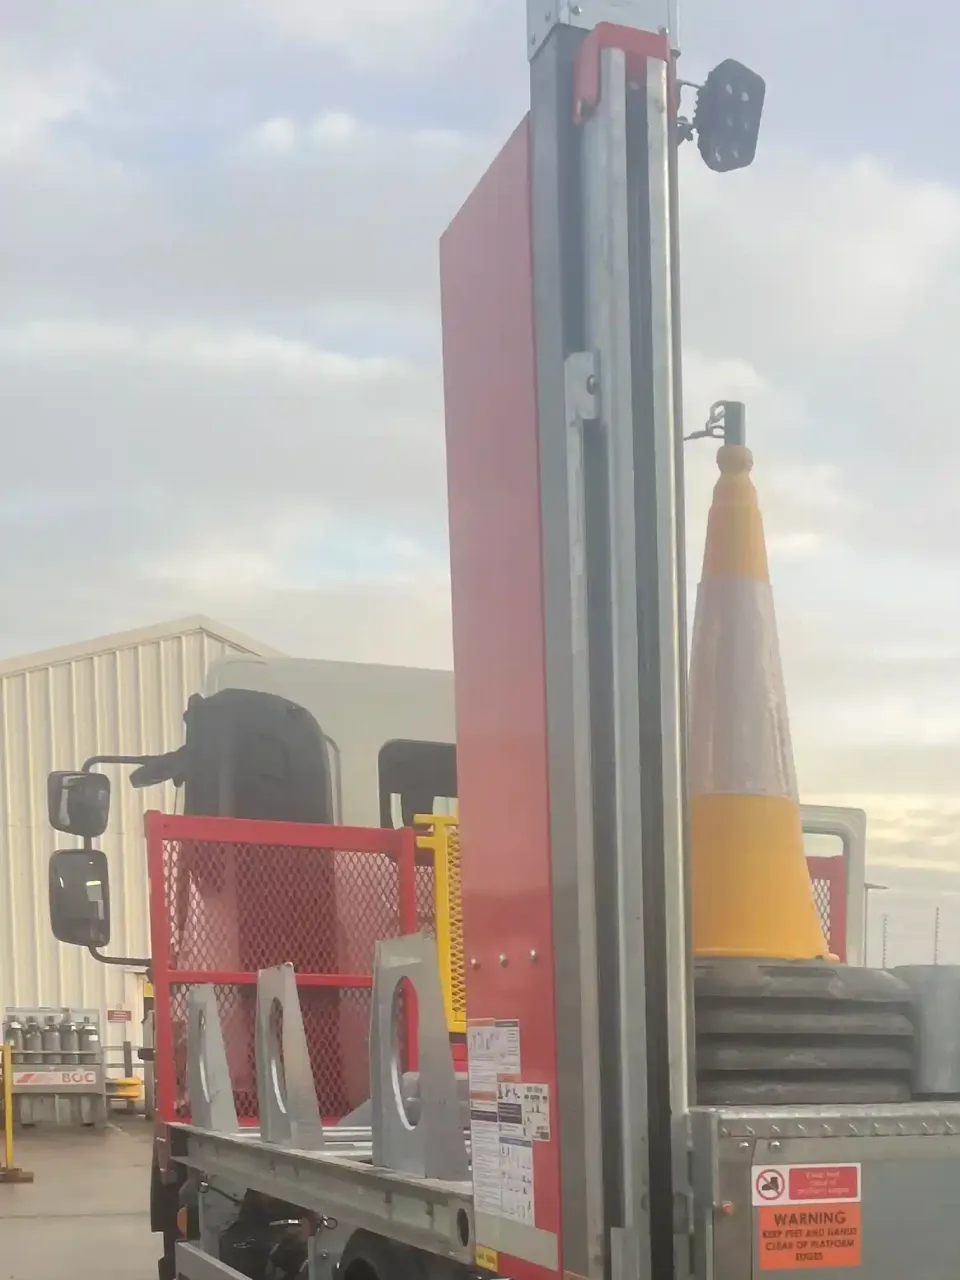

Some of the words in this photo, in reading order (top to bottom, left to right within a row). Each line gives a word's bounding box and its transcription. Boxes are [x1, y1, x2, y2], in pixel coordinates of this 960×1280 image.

[62, 1073, 95, 1083] BOC
[774, 1210, 847, 1227] WARNING
[762, 1230, 782, 1239] KEEP
[786, 1229, 803, 1238] FEET
[805, 1229, 824, 1237] AND
[828, 1227, 857, 1236] HANDS
[765, 1241, 794, 1251] CLEAR
[796, 1240, 807, 1248] OF
[811, 1239, 855, 1248] PLATFORM
